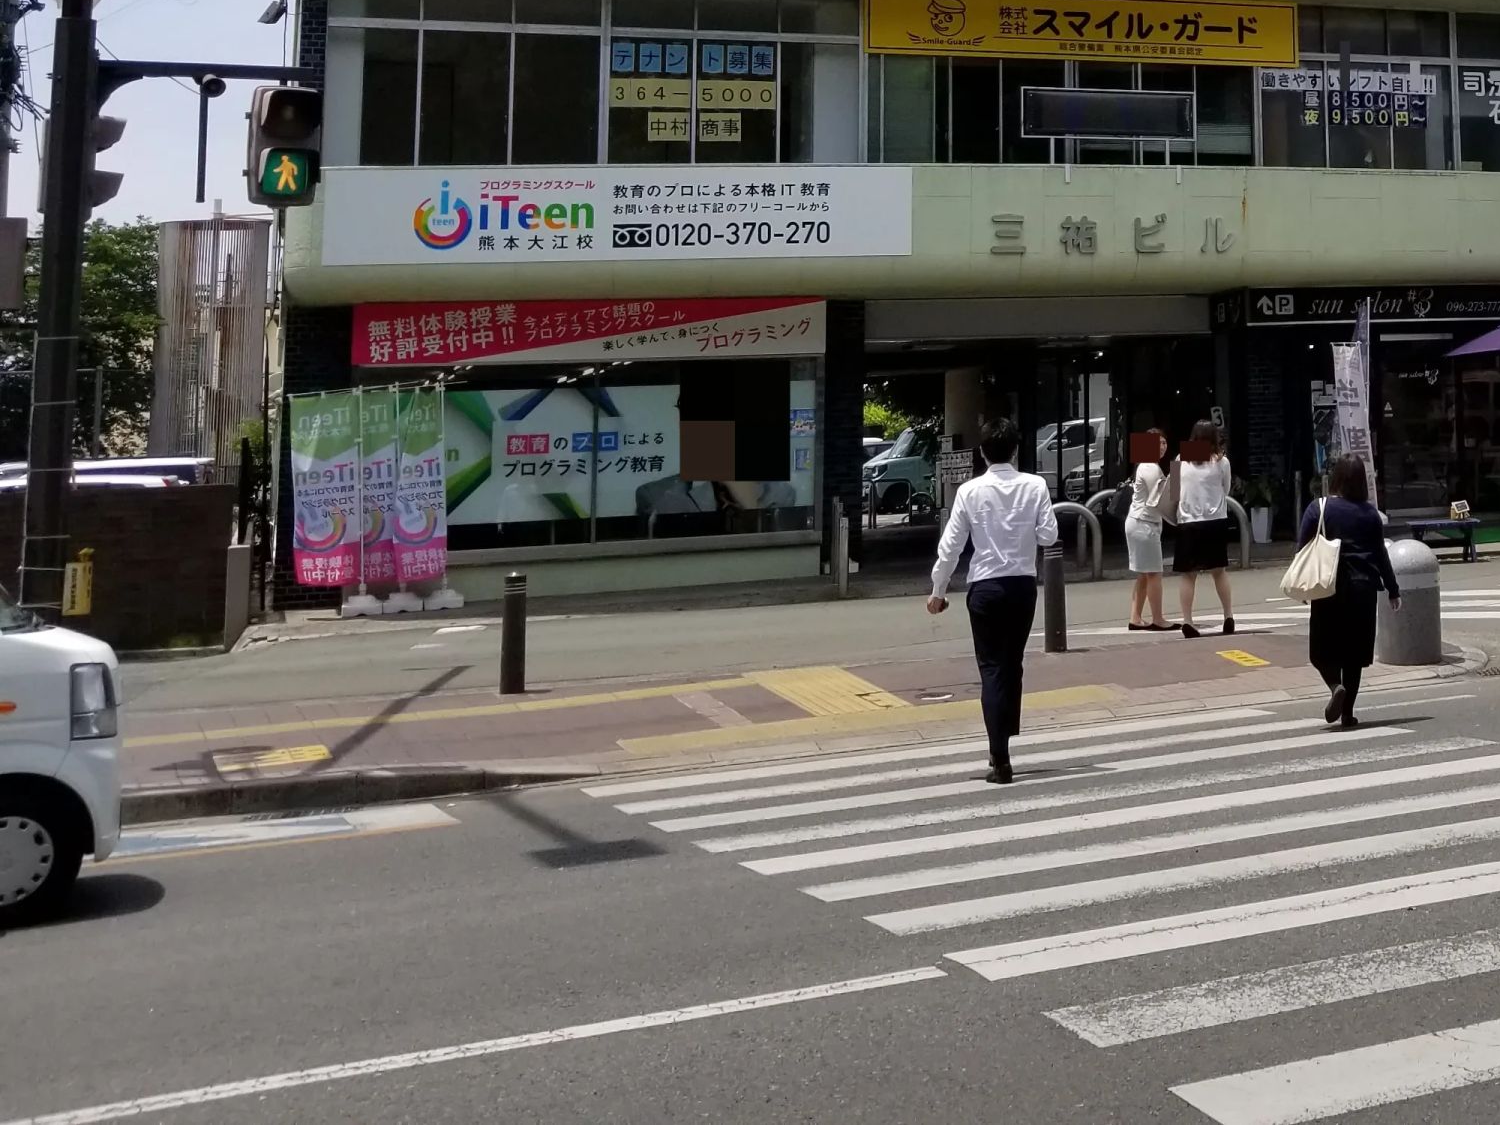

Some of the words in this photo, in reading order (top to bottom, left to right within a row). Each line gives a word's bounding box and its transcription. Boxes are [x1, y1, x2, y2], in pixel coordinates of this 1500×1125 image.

[999, 6, 1028, 20] 株式
[999, 21, 1028, 36] 会社
[1032, 8, 1258, 44] スマイル・ガード
[614, 50, 773, 71] テナント募集
[649, 118, 741, 138] 中村商事
[480, 180, 596, 191] プログラミングスクール
[479, 193, 595, 231] iTeen
[612, 202, 830, 215] お問い合わせは下記のフリーコールから
[478, 235, 593, 251] 熊本大江校
[655, 221, 831, 247] 0120-370-270
[1308, 298, 1344, 315] sun
[368, 303, 518, 342] 無料体験授業
[696, 317, 812, 352] プログラミング
[502, 455, 665, 478] プログラミング教育
